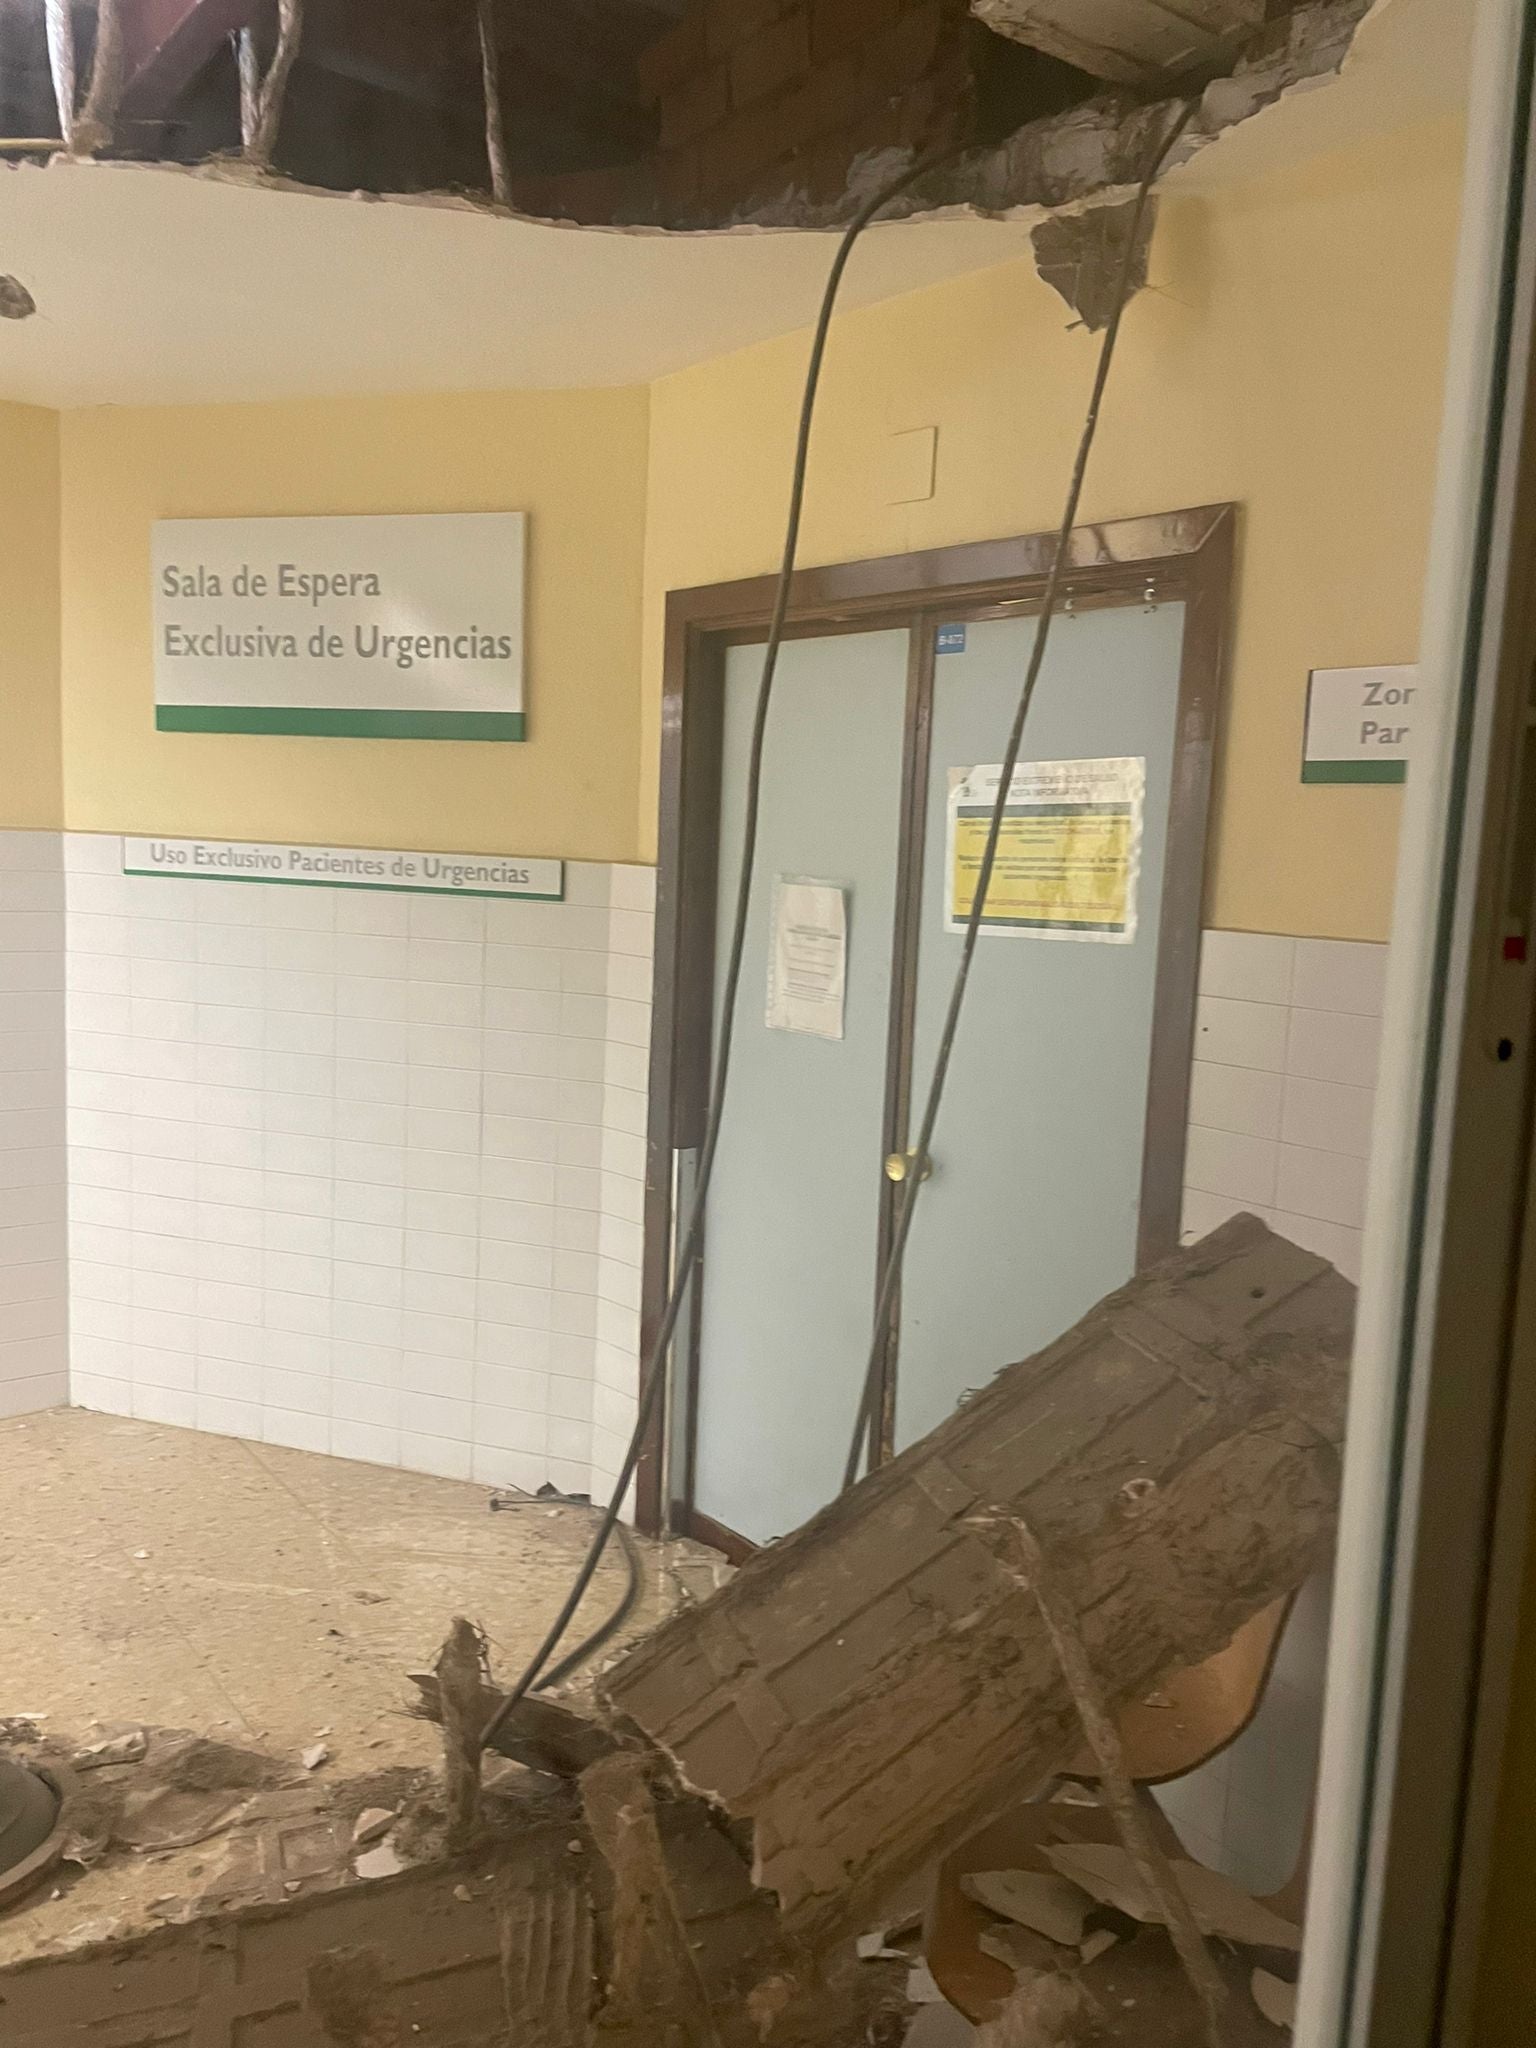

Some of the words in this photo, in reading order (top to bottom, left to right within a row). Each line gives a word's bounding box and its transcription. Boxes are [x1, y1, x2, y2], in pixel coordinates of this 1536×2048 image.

[162, 564, 224, 598] Sala
[232, 564, 268, 597] de
[277, 563, 381, 608] Espera
[163, 623, 298, 658] Exclusiva
[307, 624, 345, 658] de
[354, 624, 512, 669] Urgencias
[1360, 720, 1411, 744] Par
[150, 842, 188, 865] Uso
[193, 845, 282, 870] Exclusivo
[288, 849, 386, 876] Pacientes
[391, 856, 417, 877] de
[422, 856, 530, 887] Urgencias
